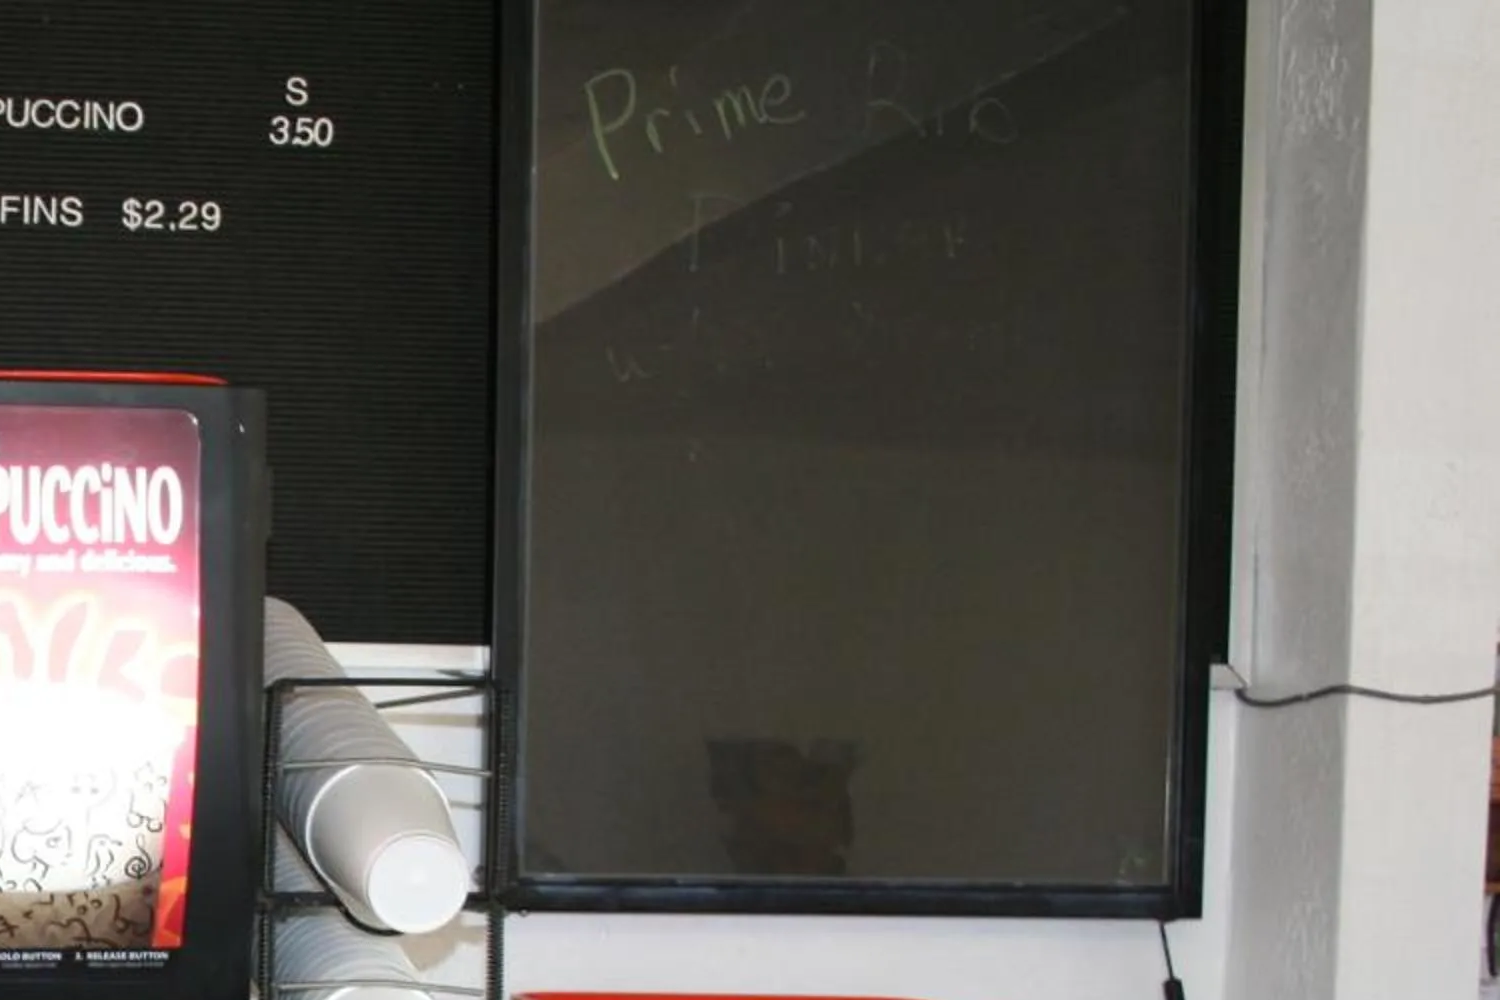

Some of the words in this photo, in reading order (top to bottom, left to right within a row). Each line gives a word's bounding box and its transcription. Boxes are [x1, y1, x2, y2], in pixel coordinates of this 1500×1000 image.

[285, 76, 309, 106] S
[582, 64, 808, 183] Prime
[122, 197, 222, 231] $2.29
